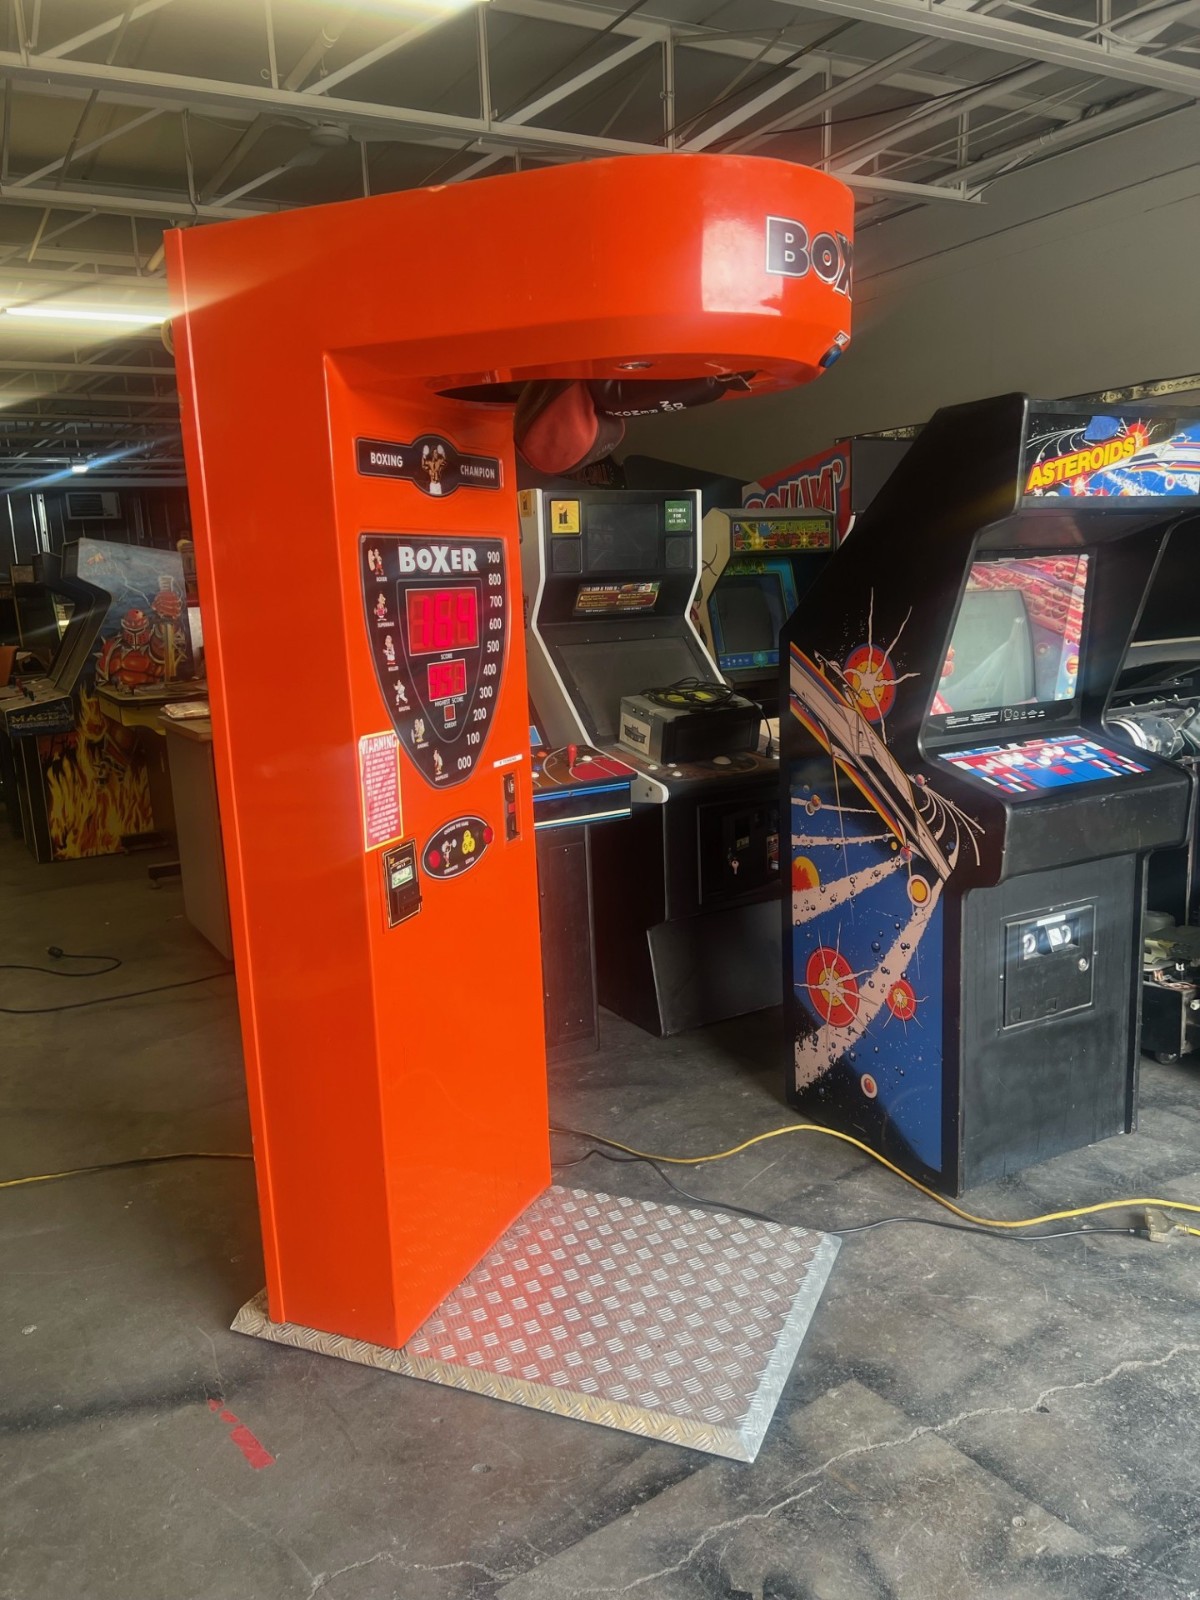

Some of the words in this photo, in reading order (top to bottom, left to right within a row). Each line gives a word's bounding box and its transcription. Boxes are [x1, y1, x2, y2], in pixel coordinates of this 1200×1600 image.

[370, 452, 403, 467] BOXING
[460, 465, 495, 479] CHAMPION
[1025, 436, 1136, 493] ASTEROIDS
[398, 546, 478, 573] BOXER
[487, 551, 500, 564] 900
[488, 573, 501, 586] 800
[489, 595, 502, 608] 700
[489, 617, 502, 630] 600
[487, 640, 500, 653] 500
[483, 663, 497, 676] 400
[479, 685, 493, 699] 300
[451, 696, 464, 704] SCORE
[473, 707, 487, 721] 200
[443, 721, 457, 729] CREDIT
[466, 731, 480, 745] 100
[457, 755, 472, 770] 000
